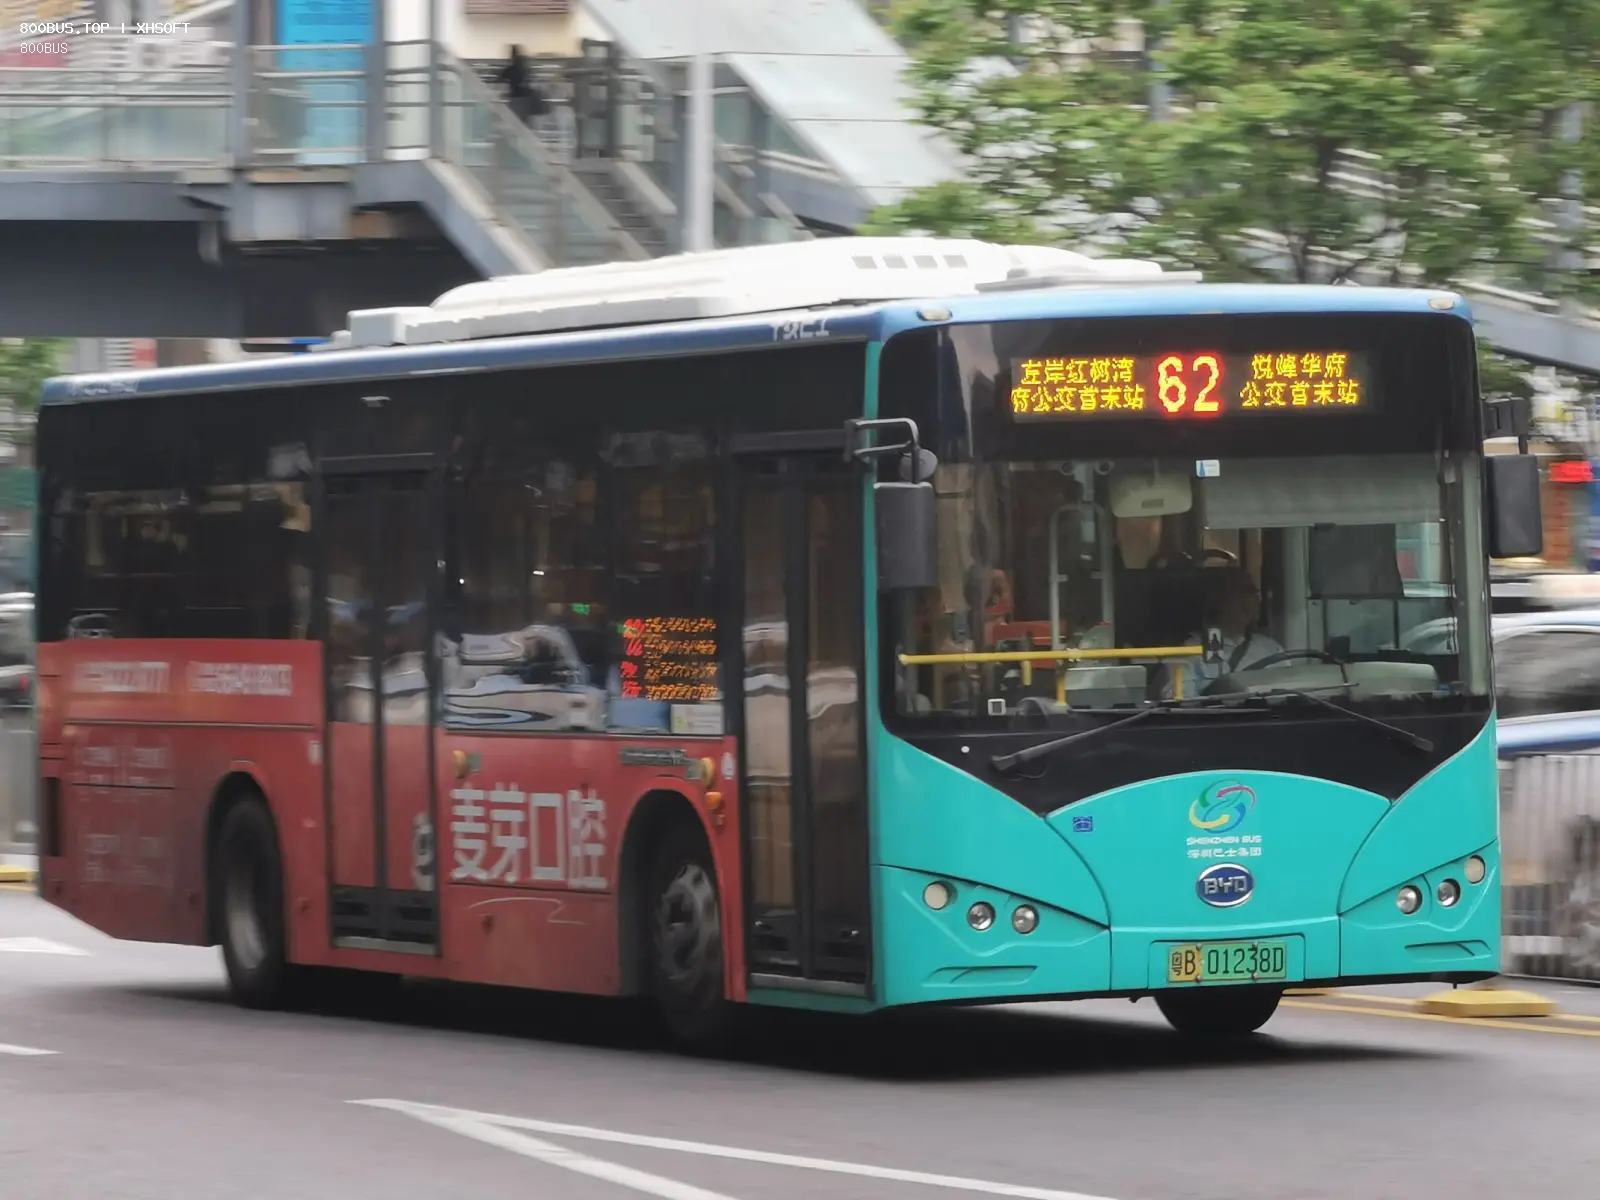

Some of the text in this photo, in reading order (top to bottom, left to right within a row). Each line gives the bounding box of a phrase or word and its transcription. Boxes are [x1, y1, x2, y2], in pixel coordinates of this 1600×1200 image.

[1020, 357, 1135, 385] 左岸红树湾
[1157, 355, 1221, 414] 62
[1011, 383, 1146, 413] 府公交首末站
[1240, 379, 1360, 407] 公交首末站
[450, 781, 608, 890] 麦芽口腔
[1242, 835, 1262, 843] BUS
[1203, 876, 1248, 894] BYD
